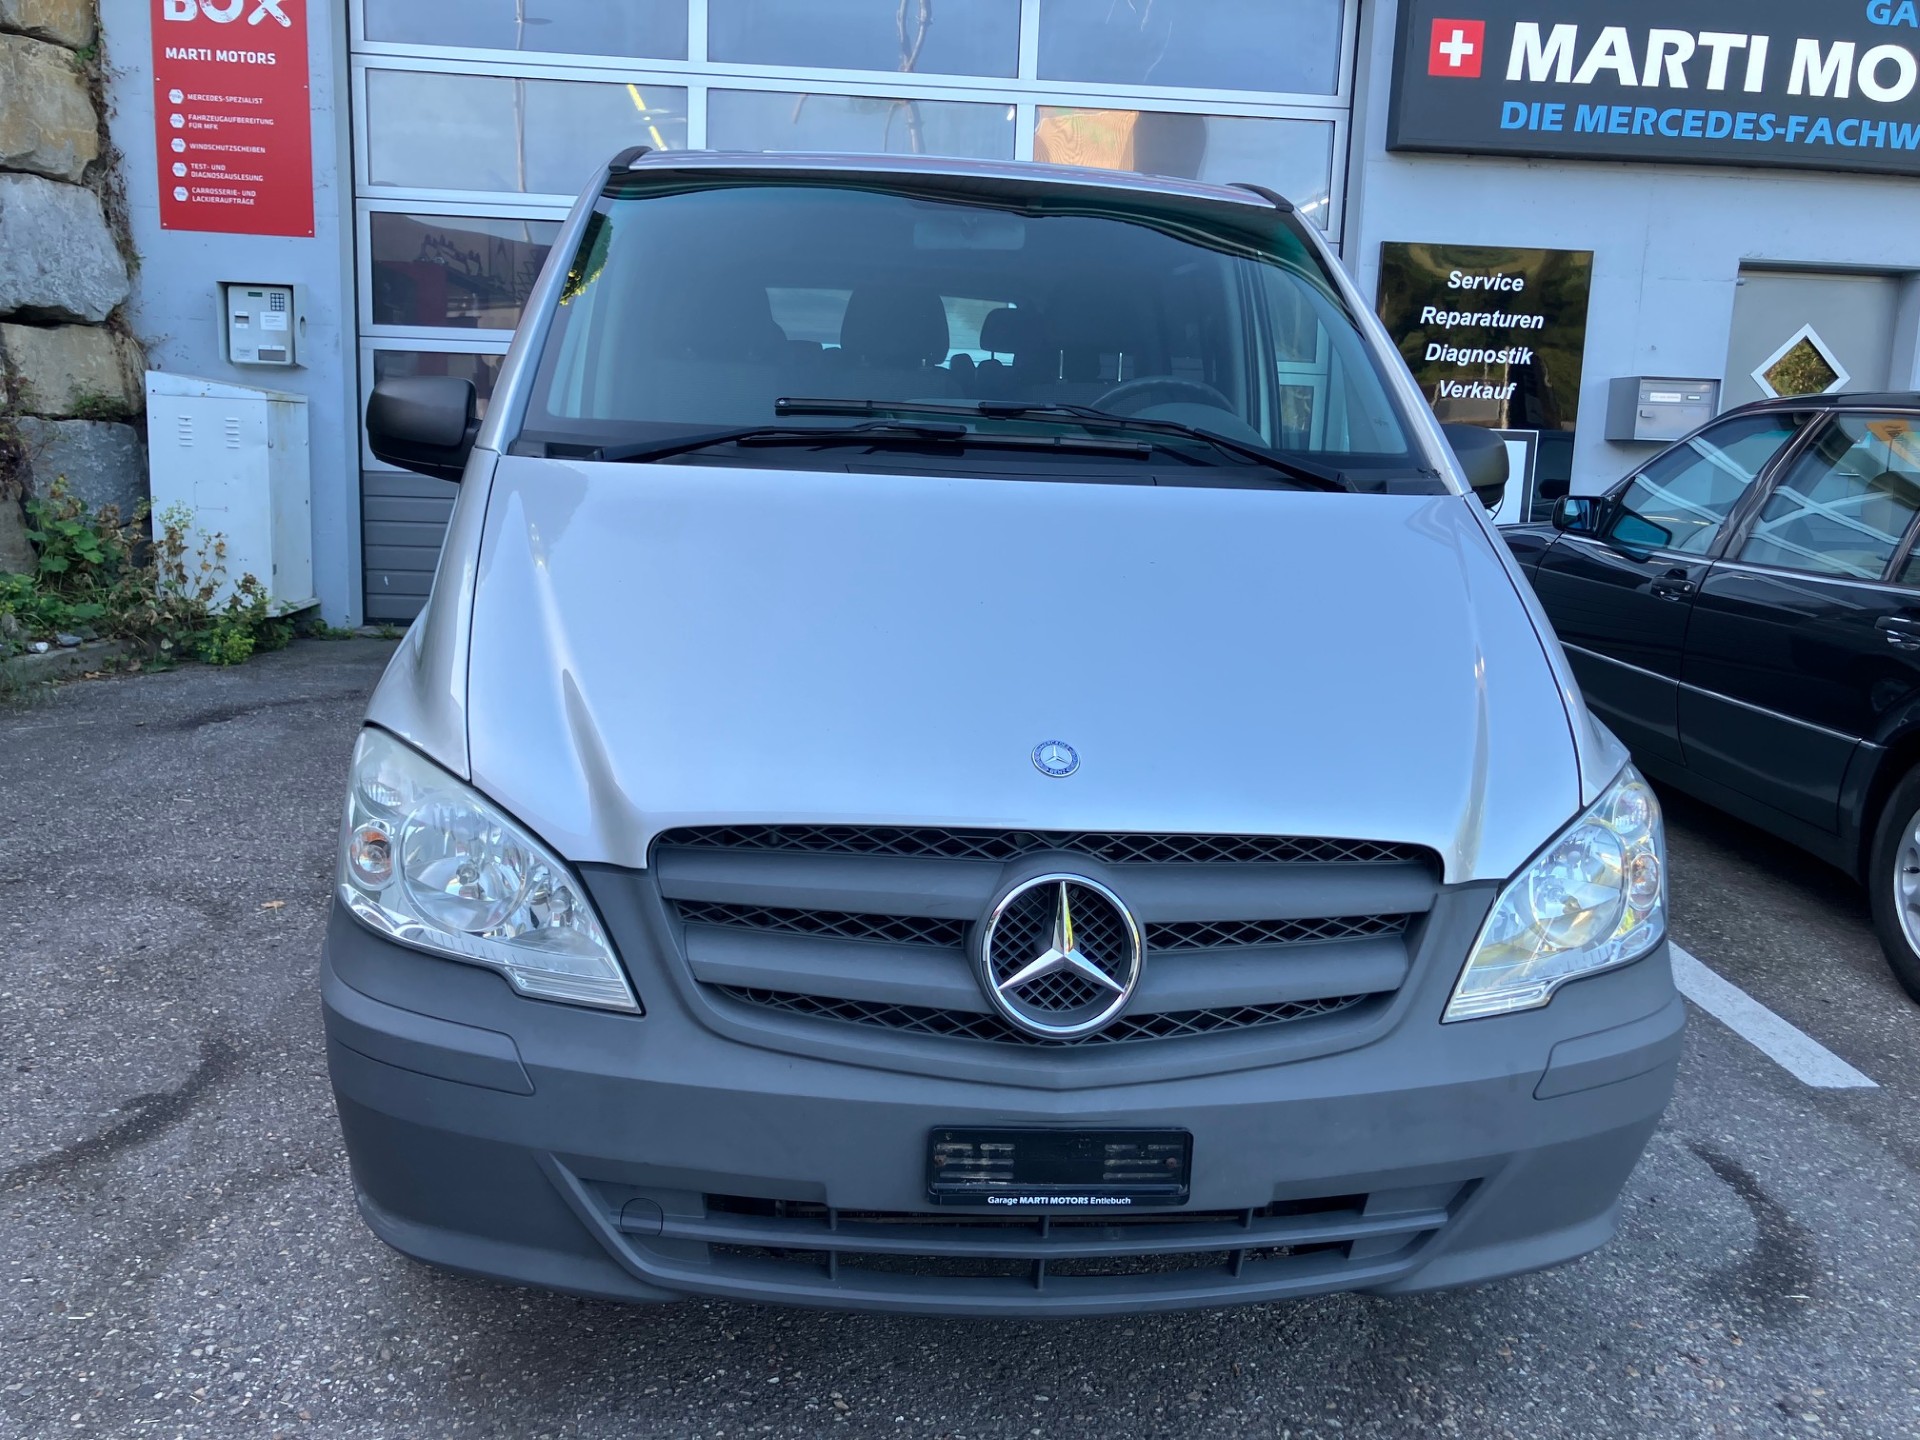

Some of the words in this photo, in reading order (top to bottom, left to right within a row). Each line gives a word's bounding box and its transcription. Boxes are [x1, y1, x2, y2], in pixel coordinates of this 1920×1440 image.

[165, 47, 211, 61] MARTI
[216, 50, 276, 65] MOTORS
[1506, 22, 1769, 93] MARTI
[1787, 38, 1917, 102] MO
[187, 93, 263, 104] MERCEDES-SPEZIALIST
[188, 114, 274, 125] FAHRZEUGAUFBEREITUNG
[1501, 101, 1565, 131] DIE
[189, 143, 266, 154] WINDSCHUTZSCHEIBEN
[191, 171, 264, 182] DIAGNOSEAUSLESUNG
[192, 187, 241, 196] CARROSSERIE-
[192, 195, 255, 206] LACKIERAUFTRÄGE
[1448, 271, 1524, 292] Service
[1420, 306, 1544, 330] Reparaturen
[1425, 343, 1533, 367] Diagnostik
[1440, 380, 1516, 400] Verkauf
[987, 1196, 1018, 1206] Garage
[1019, 1196, 1049, 1205] MARTI
[1050, 1196, 1089, 1205] MOTORS
